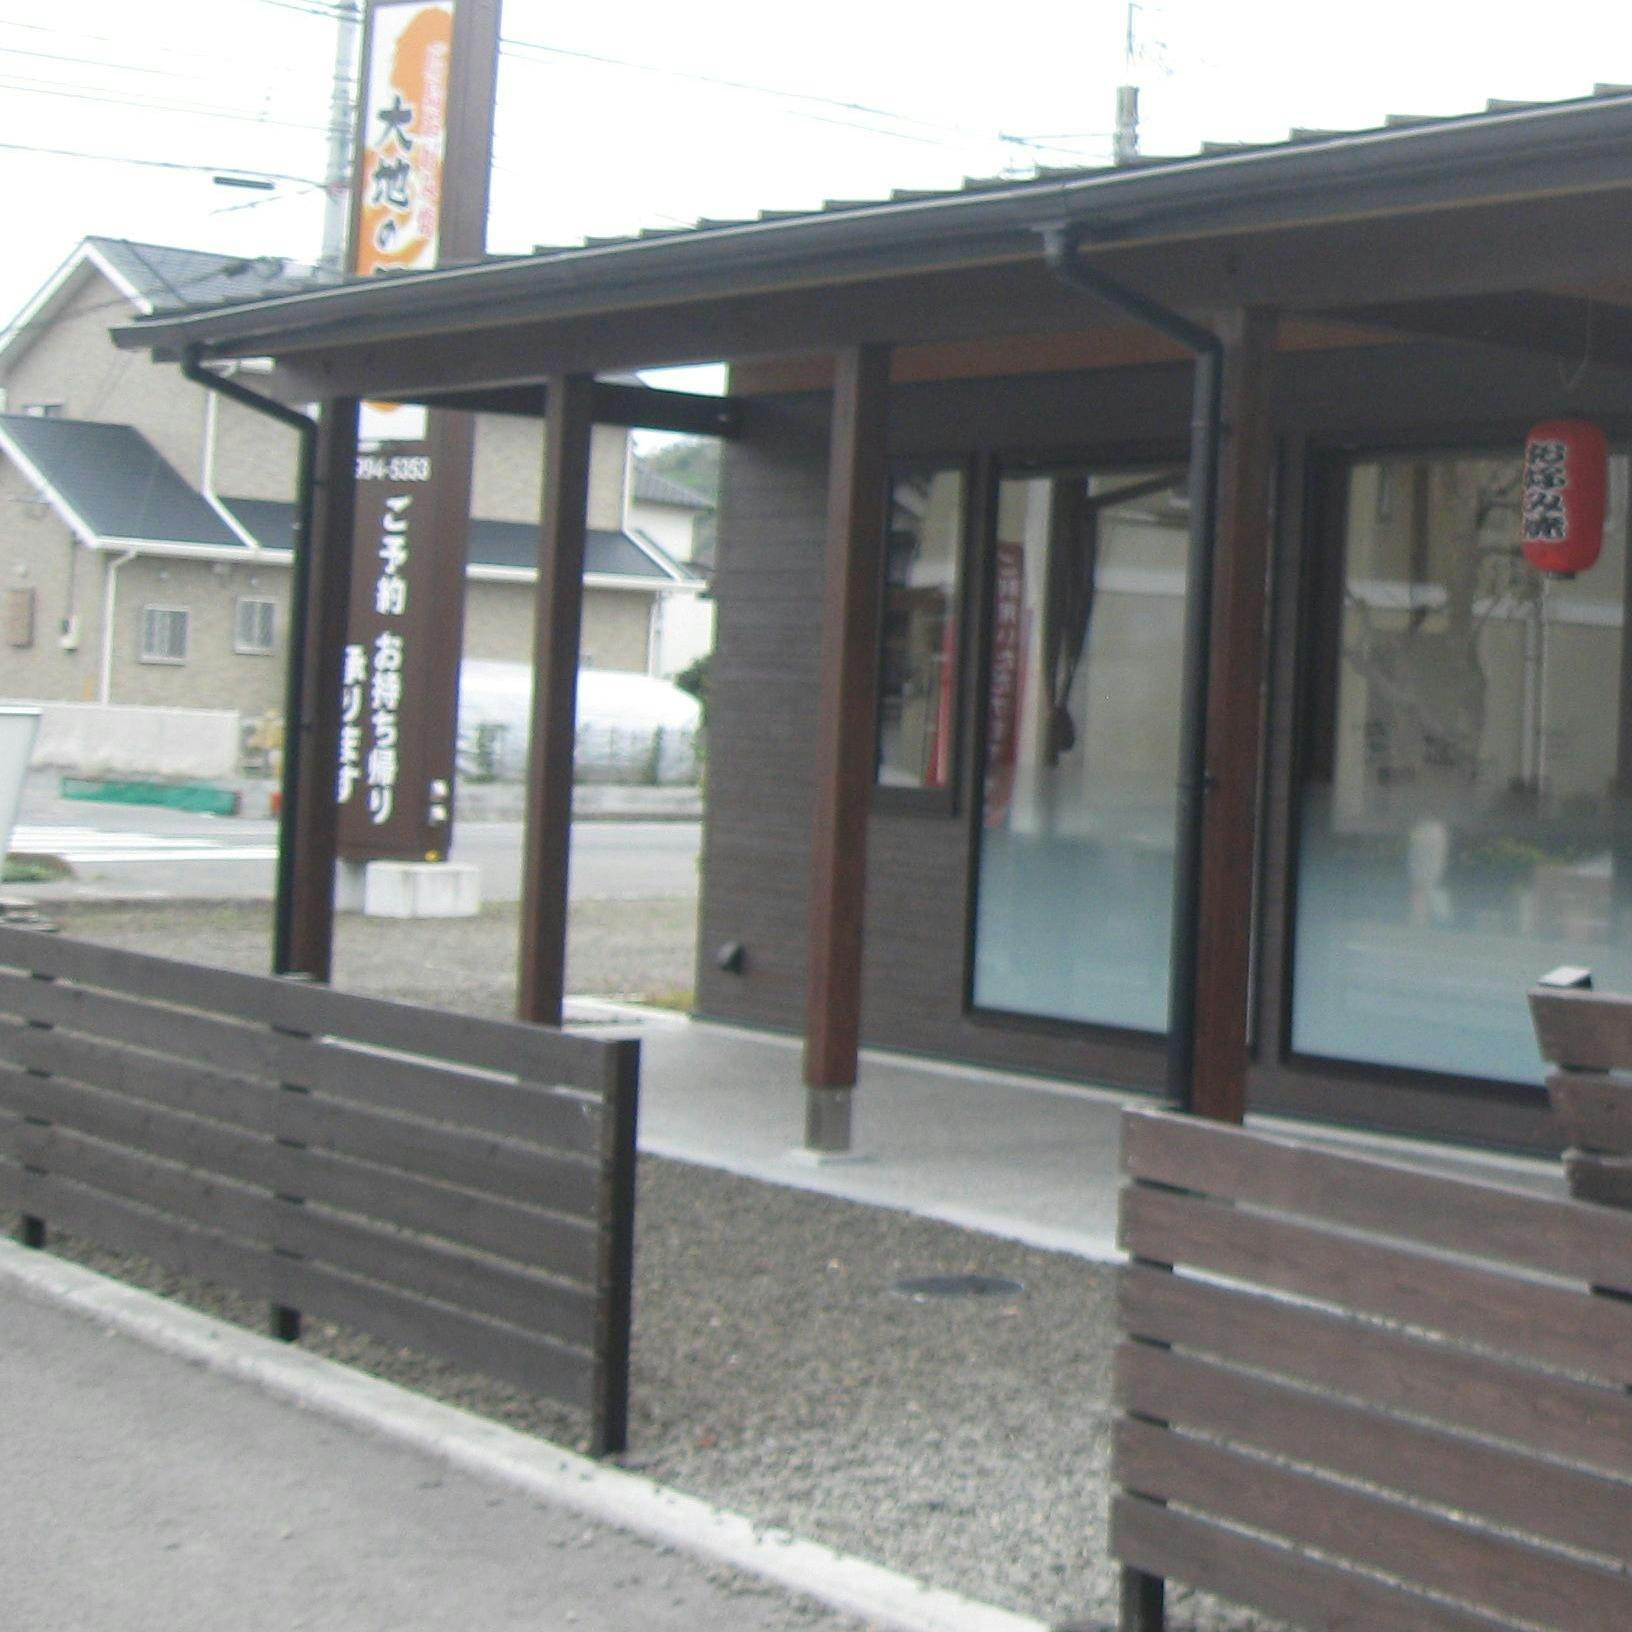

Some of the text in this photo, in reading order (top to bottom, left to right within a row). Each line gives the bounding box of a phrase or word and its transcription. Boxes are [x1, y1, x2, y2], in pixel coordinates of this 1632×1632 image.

[367, 93, 415, 277] 大地の
[376, 494, 413, 617] ご予約
[367, 631, 404, 826] お持ち帰り
